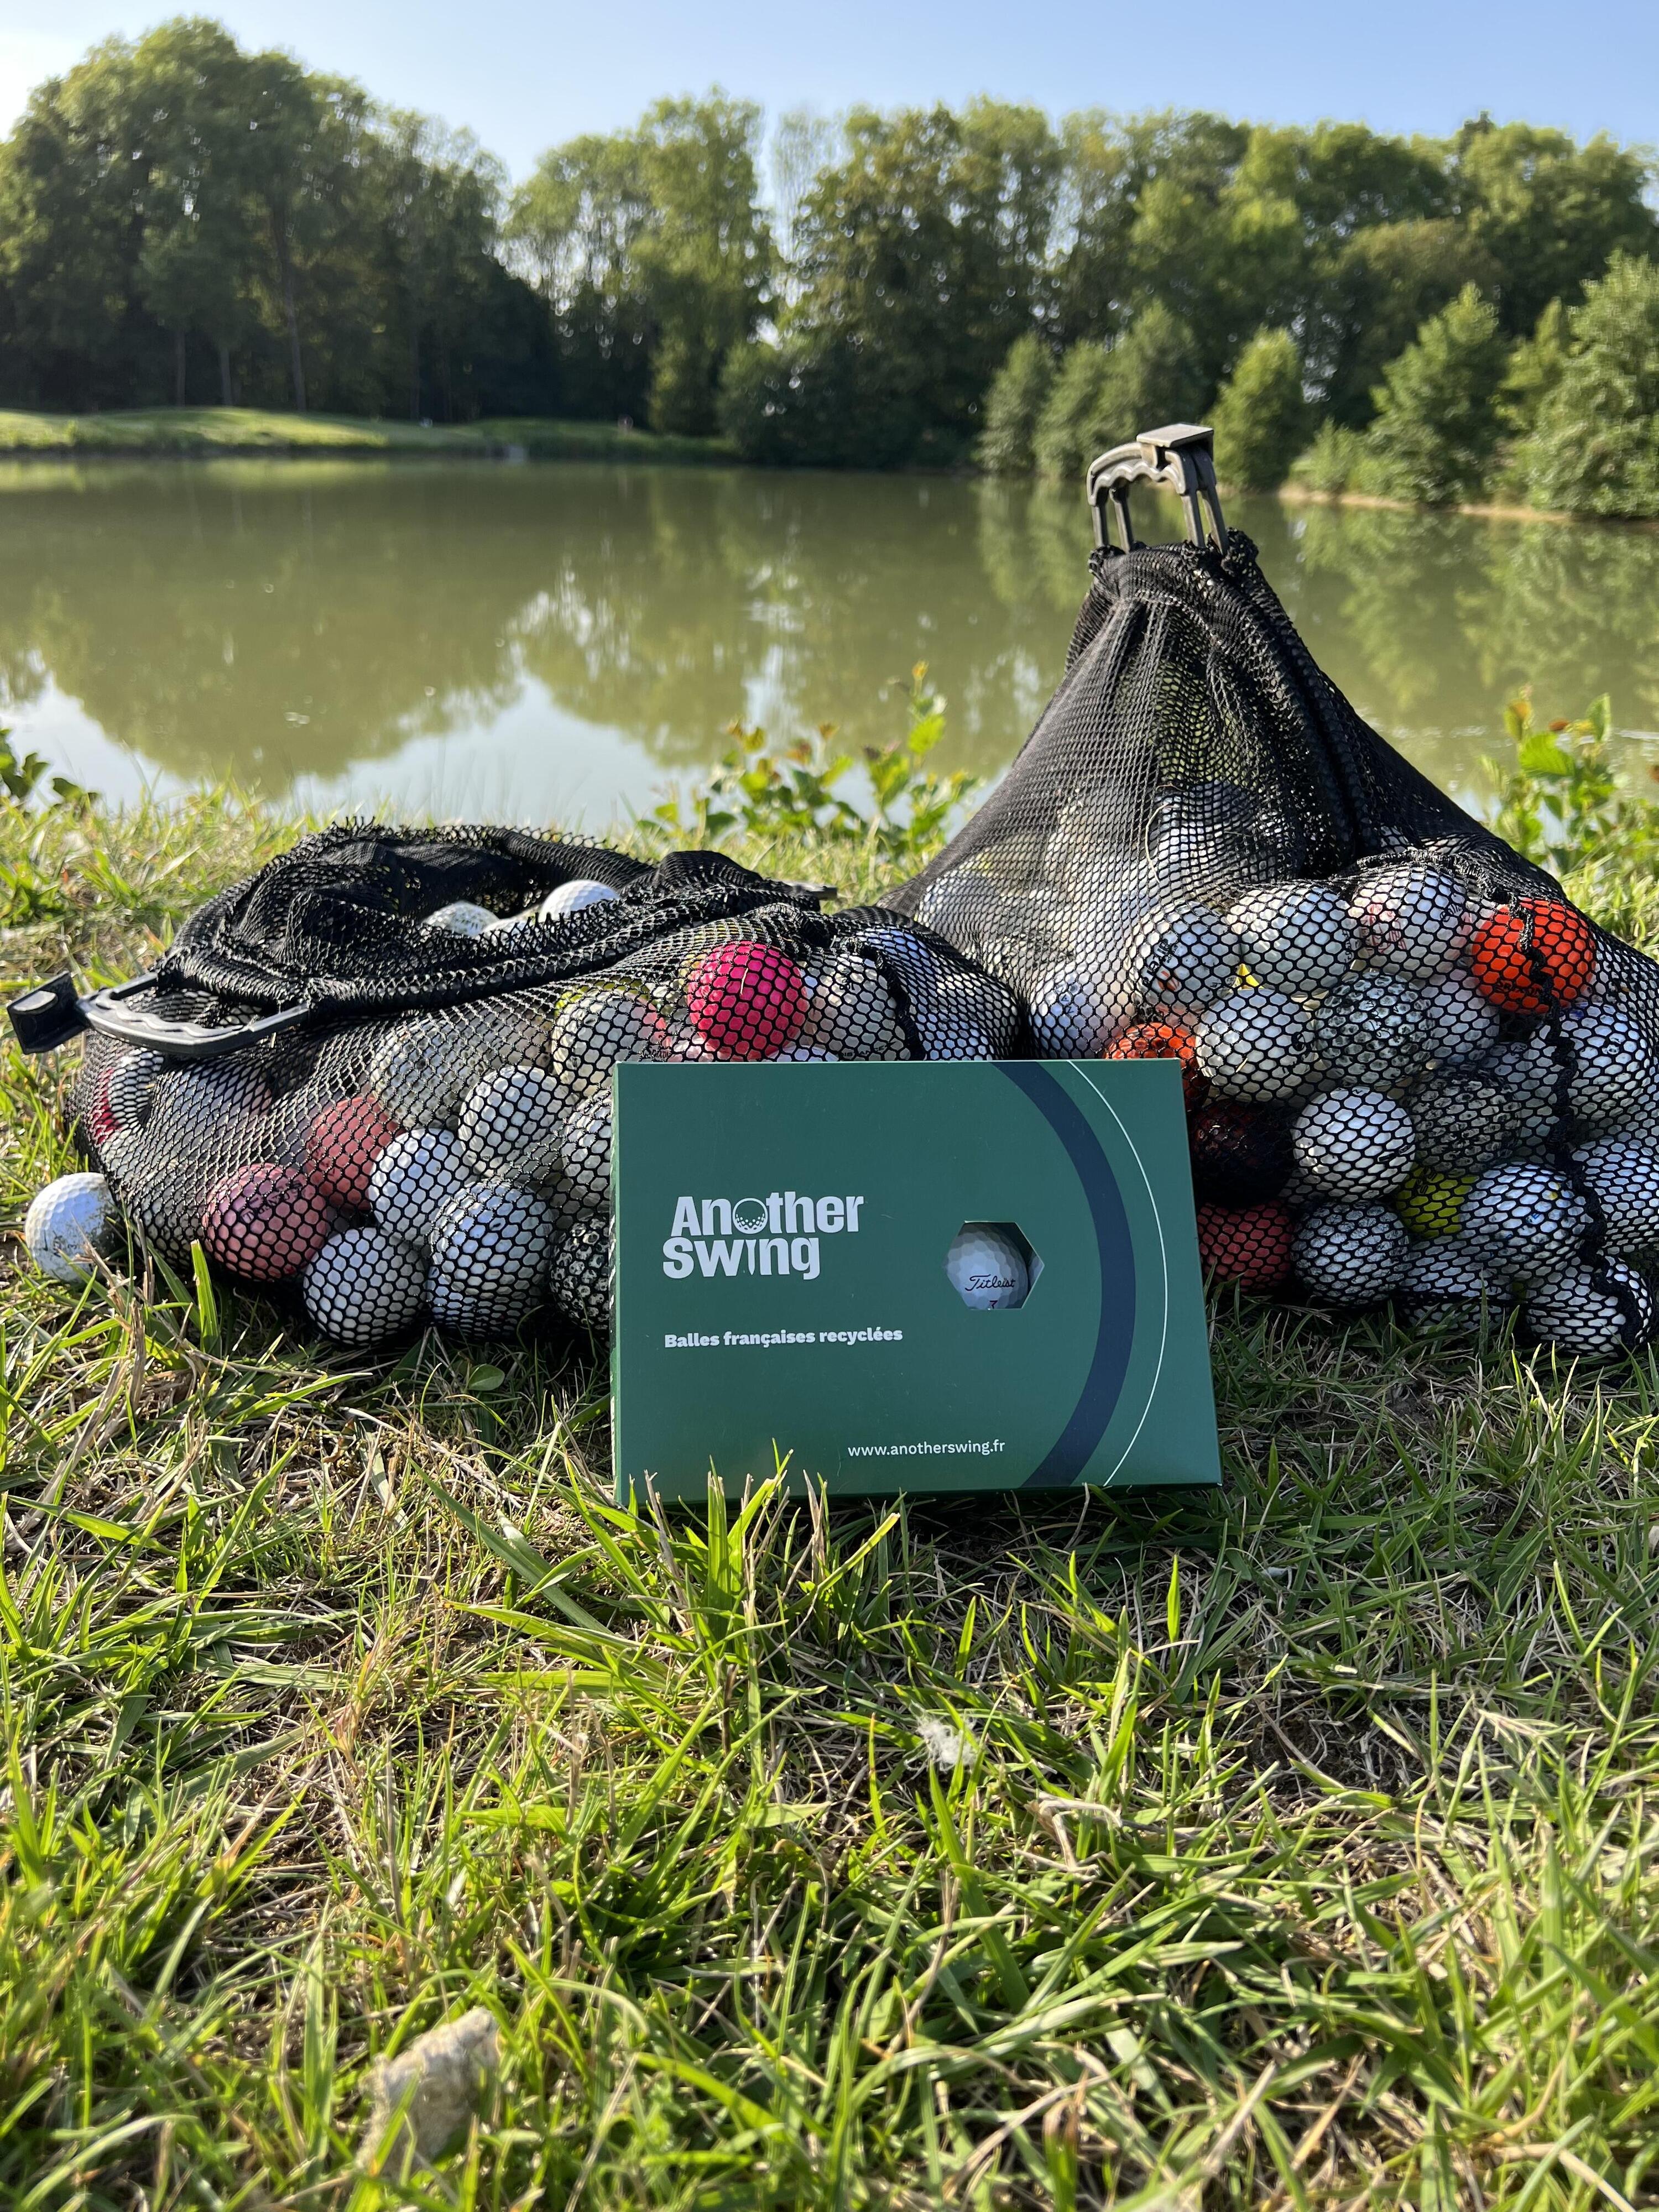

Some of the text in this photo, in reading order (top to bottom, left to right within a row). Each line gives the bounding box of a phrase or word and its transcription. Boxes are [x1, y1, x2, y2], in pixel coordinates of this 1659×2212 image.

[671, 1191, 864, 1237] Another
[662, 1237, 821, 1280] Swing
[964, 1274, 1016, 1291] Titleist
[664, 1326, 903, 1348] Balles françaises recyclées
[847, 1439, 1006, 1457] www.anotherswing.fr
